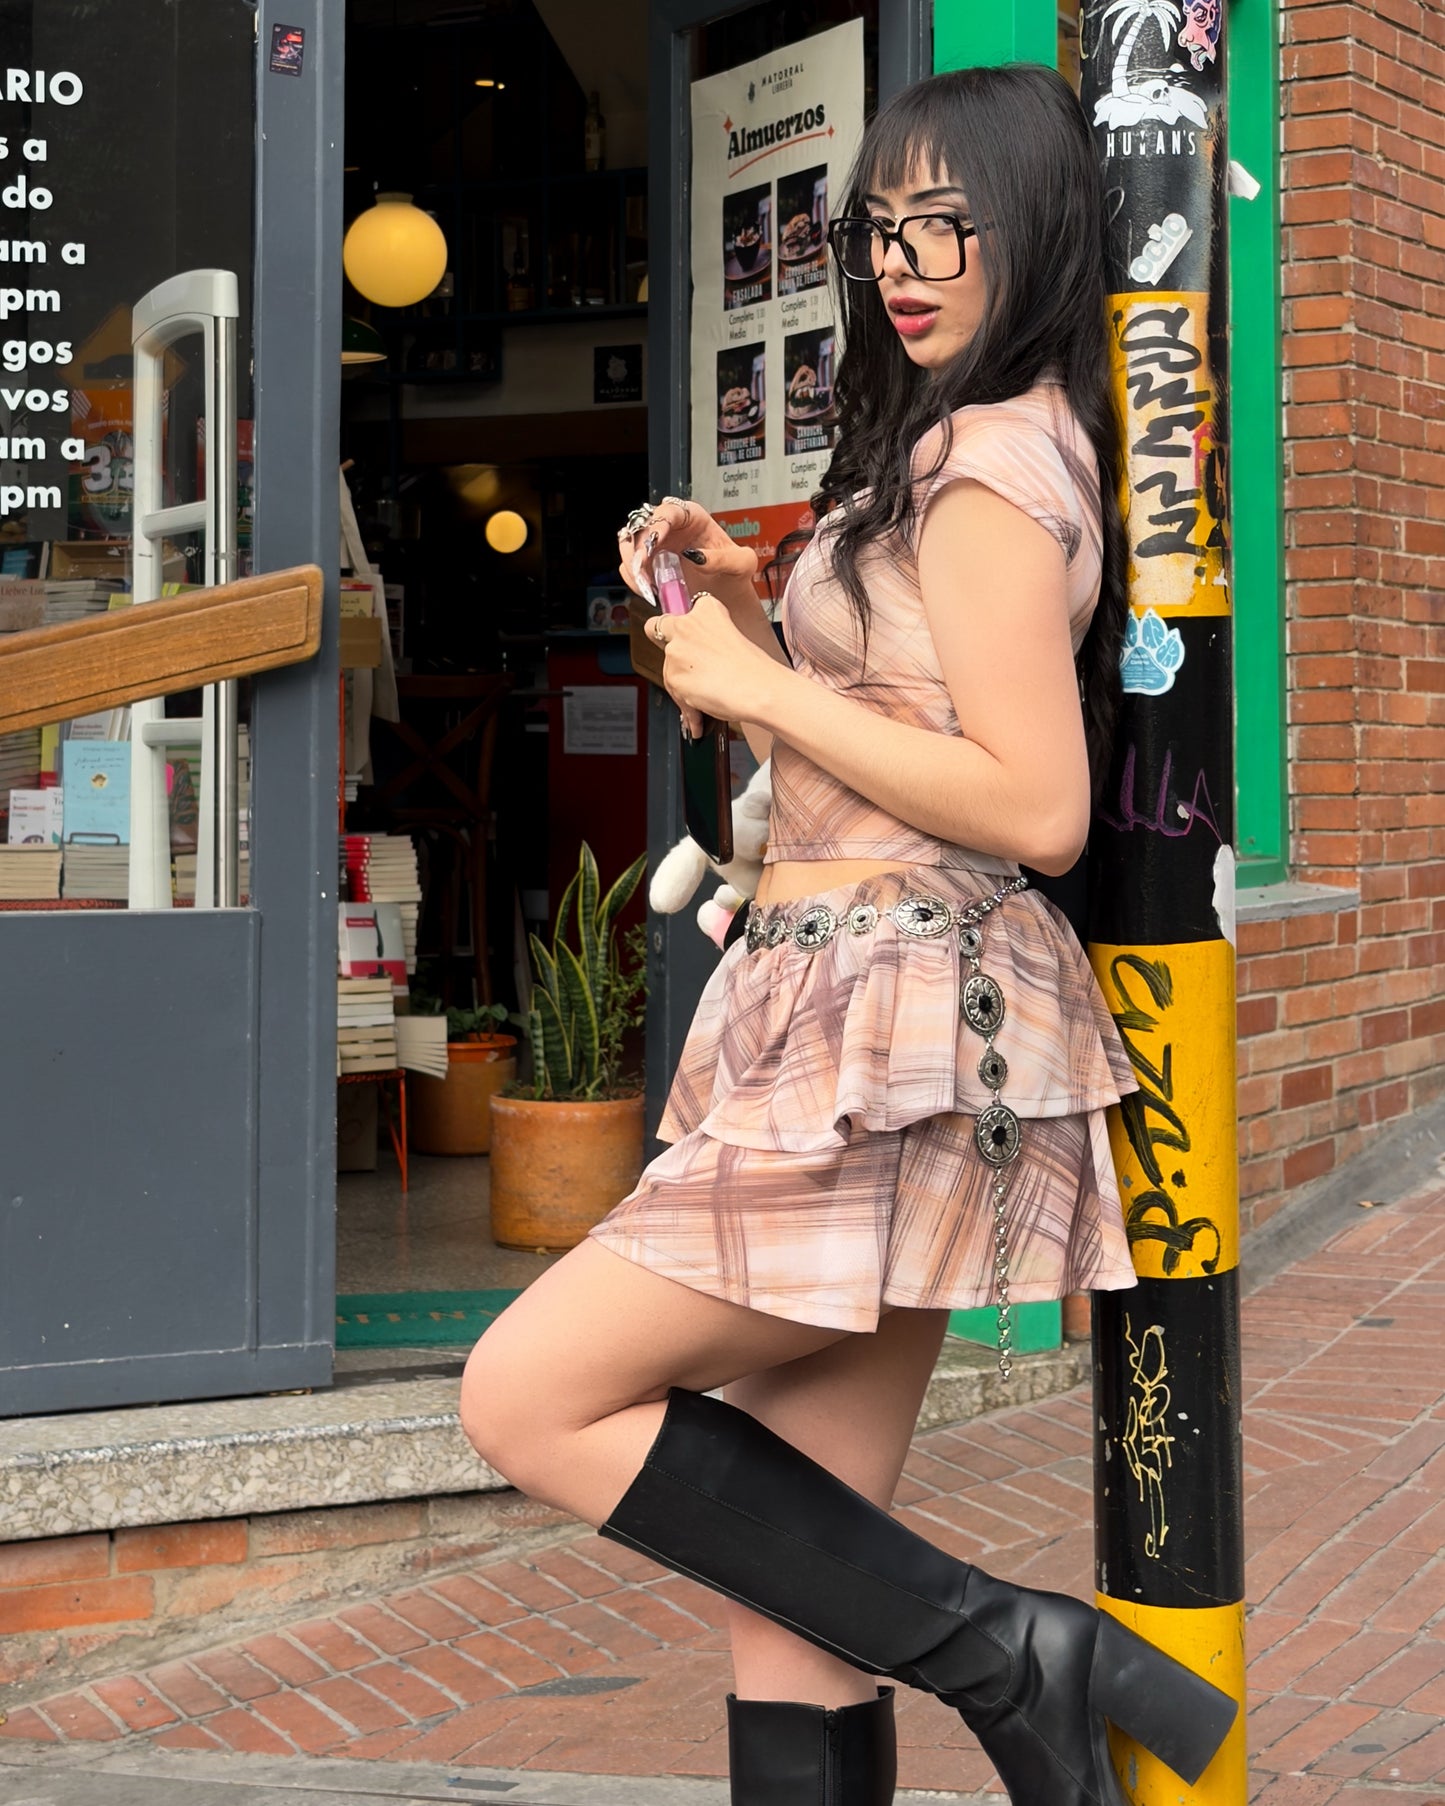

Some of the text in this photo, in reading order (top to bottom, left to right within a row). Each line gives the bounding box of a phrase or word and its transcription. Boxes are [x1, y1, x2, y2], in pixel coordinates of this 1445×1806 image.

[0, 68, 84, 106] RIO
[761, 63, 804, 87] MATORRAL
[728, 104, 825, 160] Almuerzos
[22, 138, 47, 162] a
[2, 174, 53, 210] do
[61, 242, 85, 265] a
[0, 288, 60, 320] pm
[2, 340, 73, 372] gos
[0, 388, 70, 413] vos
[61, 438, 85, 461] a
[0, 485, 61, 515] pm
